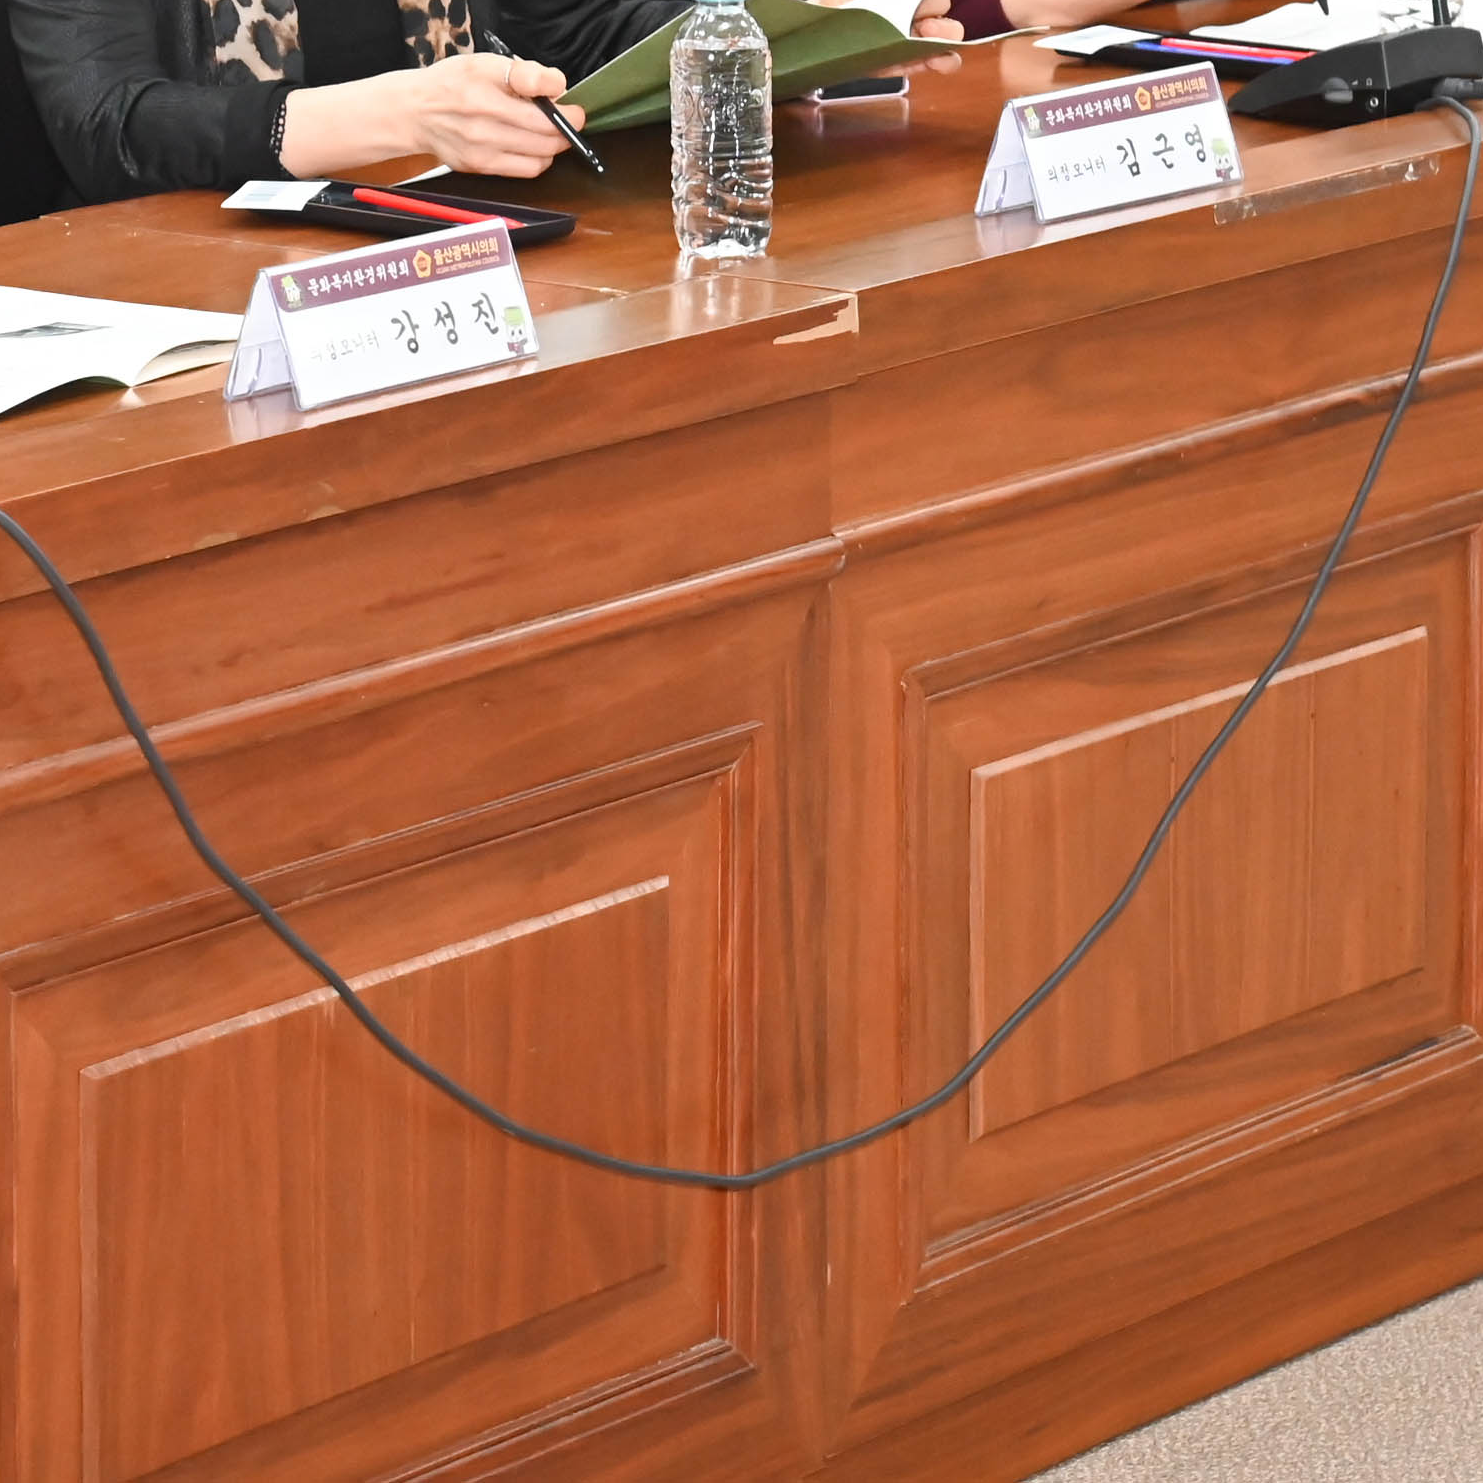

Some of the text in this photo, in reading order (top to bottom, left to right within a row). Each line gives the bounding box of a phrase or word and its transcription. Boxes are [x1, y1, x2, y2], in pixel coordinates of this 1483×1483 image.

[1045, 93, 1132, 127] 문화복지환경위원회
[1151, 76, 1208, 102] 울산광역시의회
[1047, 122, 1207, 183] 의정모니터 김근영
[307, 236, 499, 297] 문화복지환경위원회 울산광역시의회
[390, 292, 500, 355] 강성진
